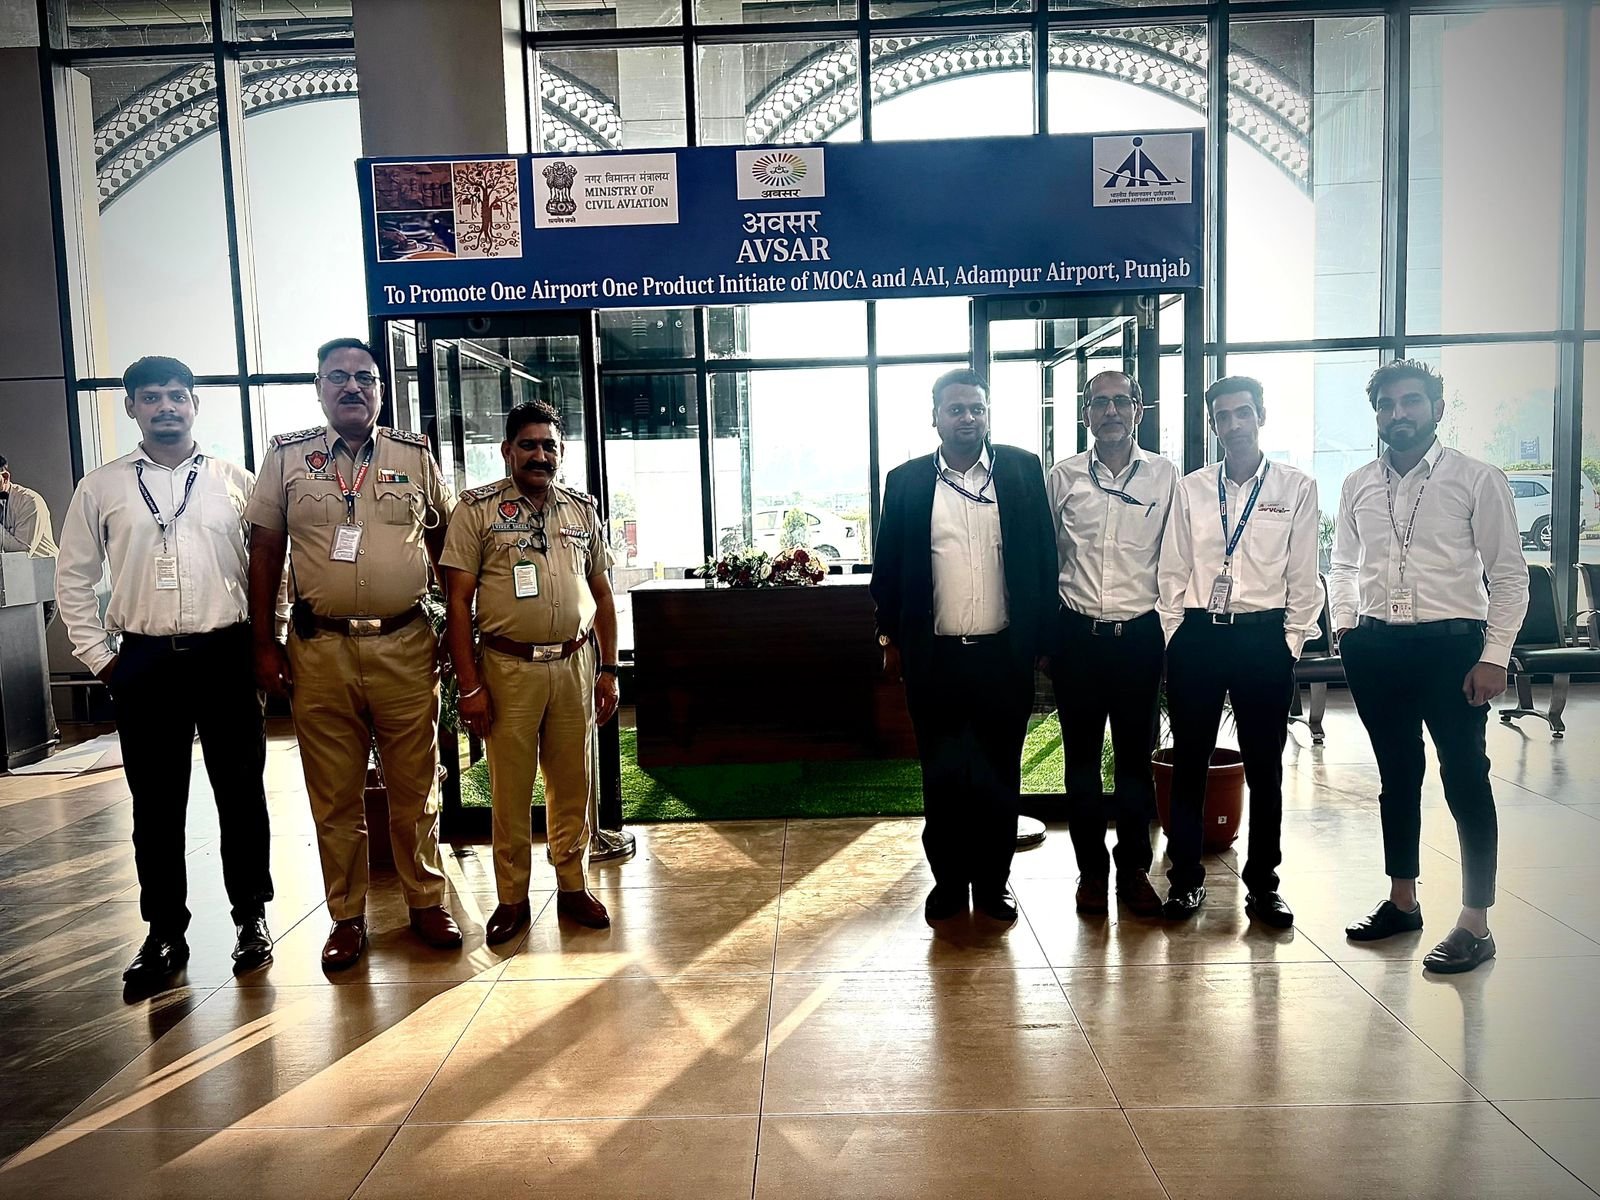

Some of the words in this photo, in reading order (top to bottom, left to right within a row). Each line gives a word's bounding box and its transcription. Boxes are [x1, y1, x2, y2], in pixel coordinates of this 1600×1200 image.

[584, 174, 602, 184] नगर
[605, 172, 636, 184] विमानन
[639, 171, 670, 182] मंत्रालय
[585, 186, 638, 197] MINISTRY
[640, 185, 655, 196] OF
[761, 188, 801, 198] अवसर
[585, 199, 615, 210] CIVIL
[617, 197, 669, 209] AVIATION
[742, 210, 822, 235] अवसर
[735, 236, 831, 264] AVSAR
[384, 285, 406, 305] To
[409, 283, 487, 304] Promote
[490, 281, 527, 301] One
[530, 279, 599, 304] Airport
[602, 277, 638, 297] One
[642, 275, 715, 296] Product
[718, 273, 786, 294] Initiate
[791, 270, 811, 292] of
[812, 269, 868, 291] MOCA
[872, 267, 907, 288] and
[910, 266, 950, 289] AAI,
[954, 264, 1042, 289] Adampur
[1046, 261, 1121, 286] Airport,
[1124, 257, 1191, 283] Punjab
